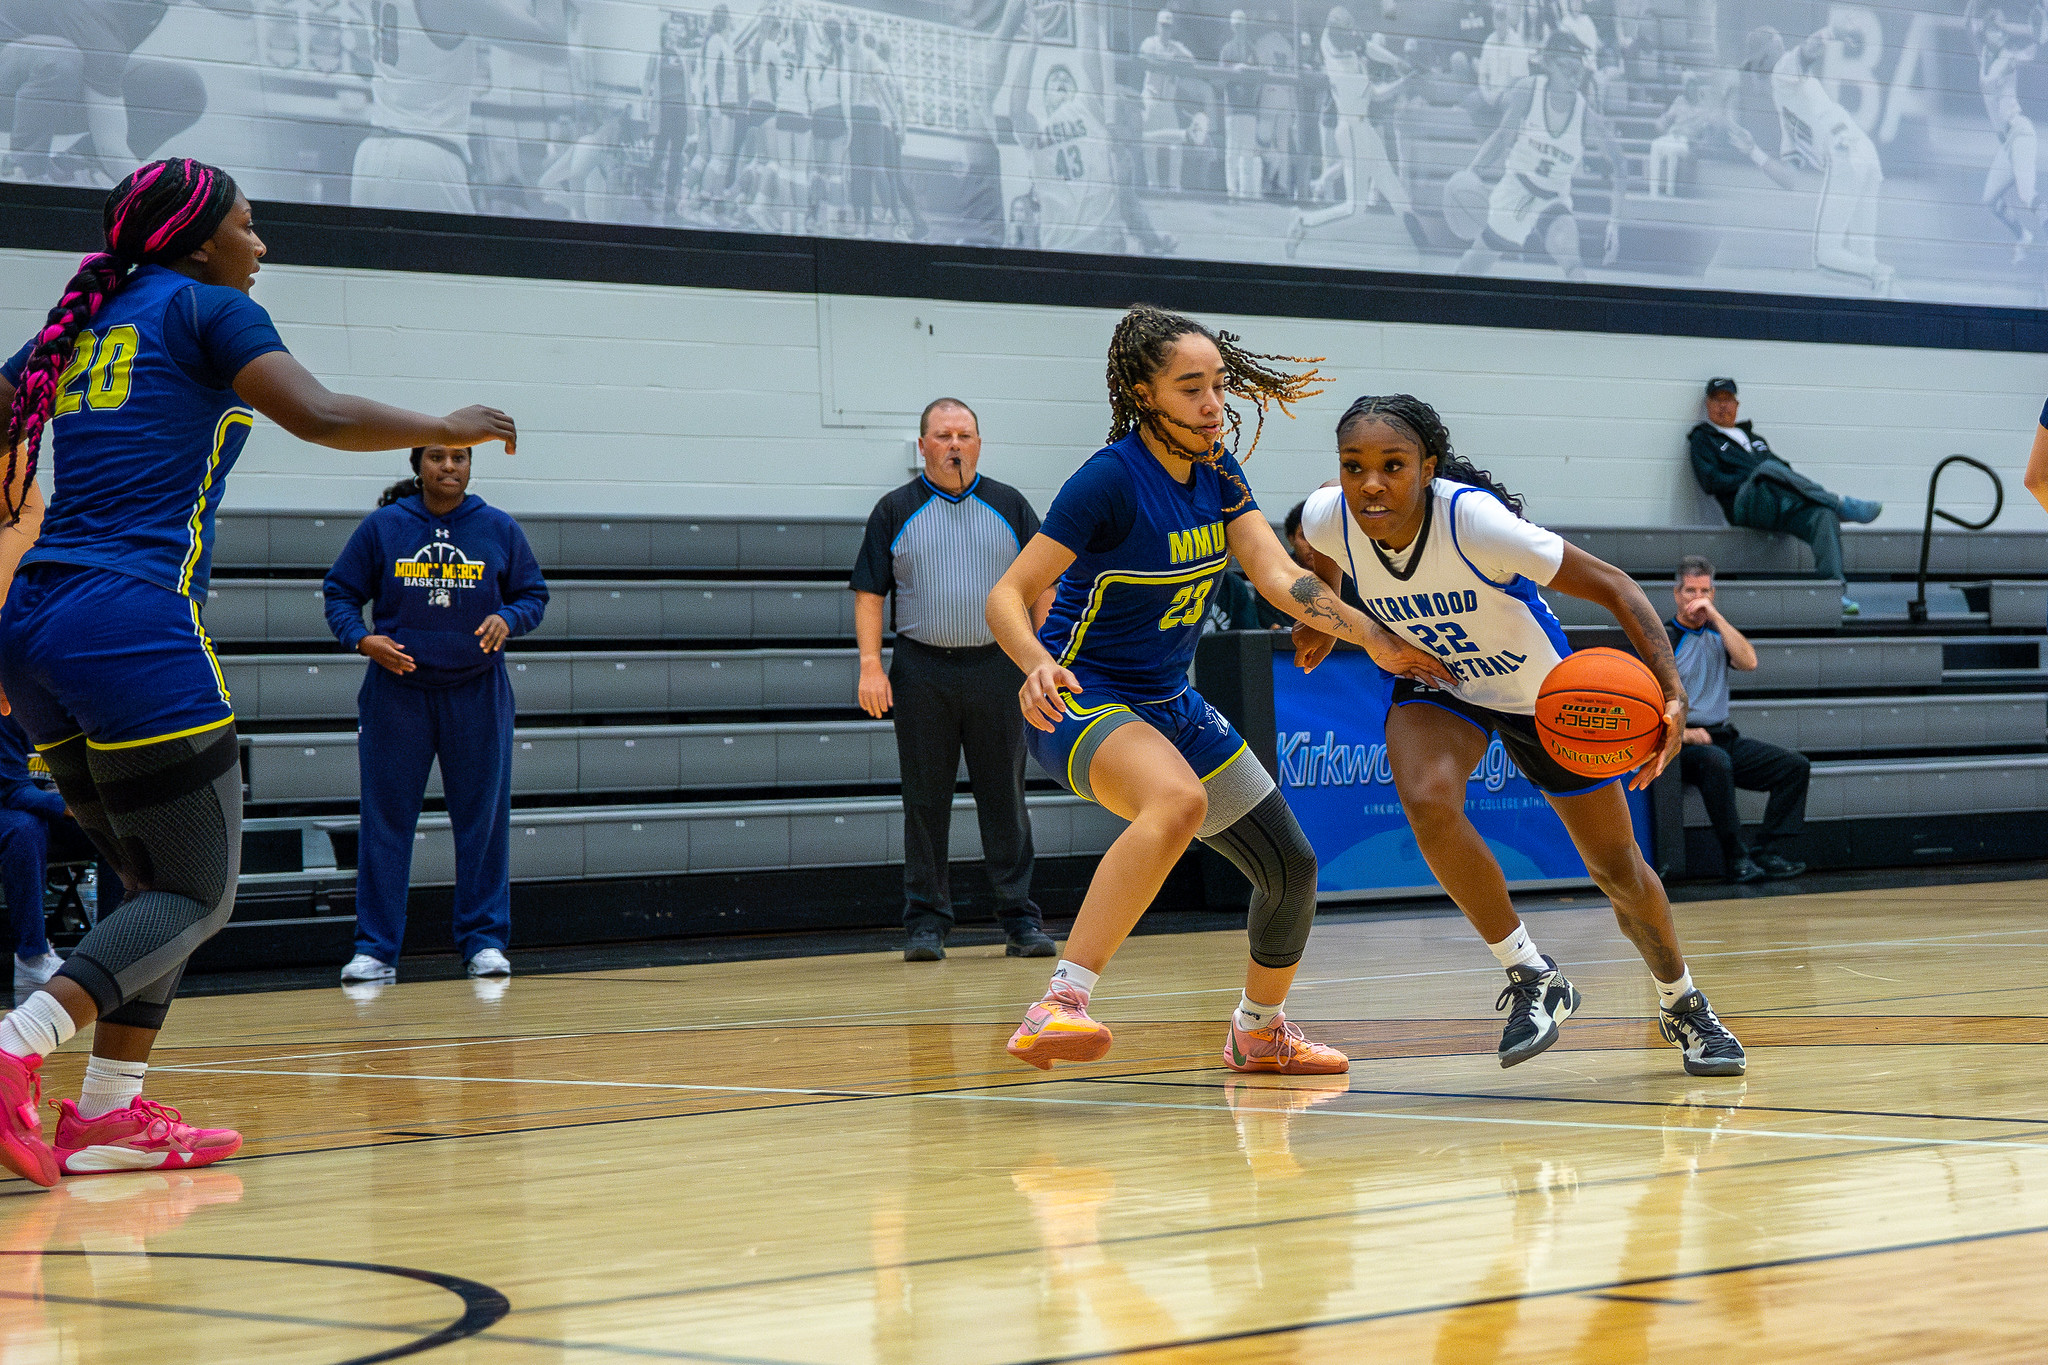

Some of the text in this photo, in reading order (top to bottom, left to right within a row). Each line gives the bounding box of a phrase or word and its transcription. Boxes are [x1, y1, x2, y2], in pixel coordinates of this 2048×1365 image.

[1055, 145, 1085, 182] 43
[53, 323, 140, 420] 20
[1167, 520, 1226, 564] MMU
[403, 577, 477, 588] BASKETBALL
[441, 563, 485, 580] MERCY
[1158, 578, 1214, 631] 23
[1366, 589, 1478, 622] KIRKWOOD
[1406, 621, 1481, 656] 22
[1441, 649, 1528, 683] KETBALL
[1554, 712, 1631, 731] LEGACY
[1561, 703, 1607, 714] 1000
[1277, 730, 1394, 788] Kirkwo
[1551, 739, 1635, 765] SPALDING
